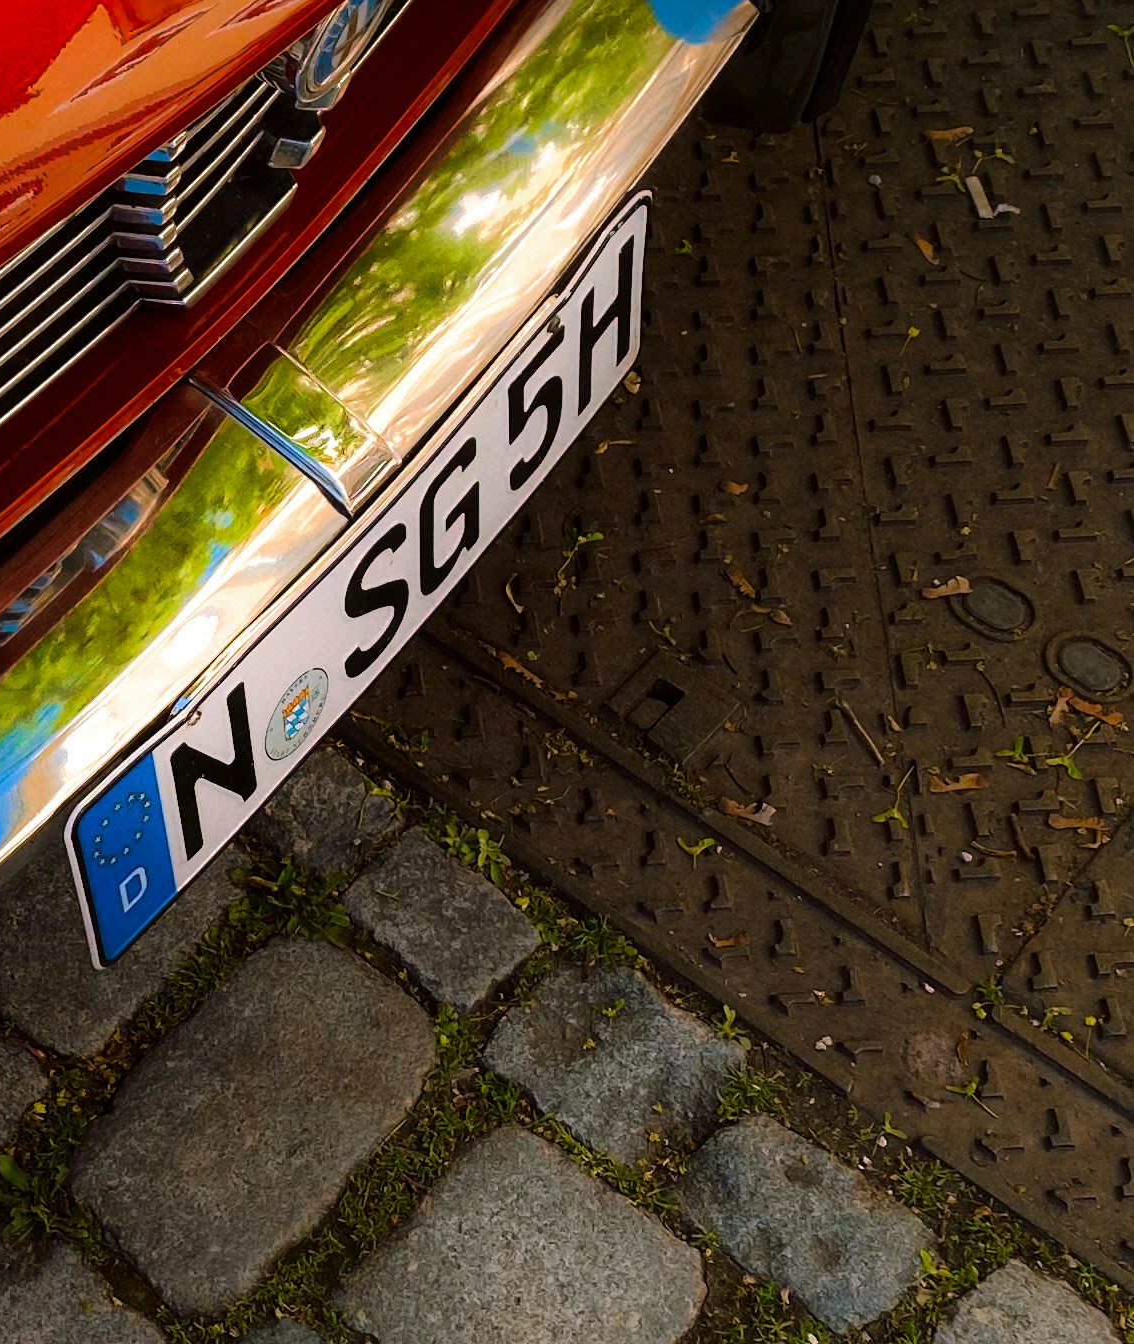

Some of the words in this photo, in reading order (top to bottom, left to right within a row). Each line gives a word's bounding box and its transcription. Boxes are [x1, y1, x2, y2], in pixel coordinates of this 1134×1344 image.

[170, 681, 258, 862] N
[345, 436, 480, 679] SG
[507, 234, 635, 492] 5H
[119, 866, 148, 914] D
